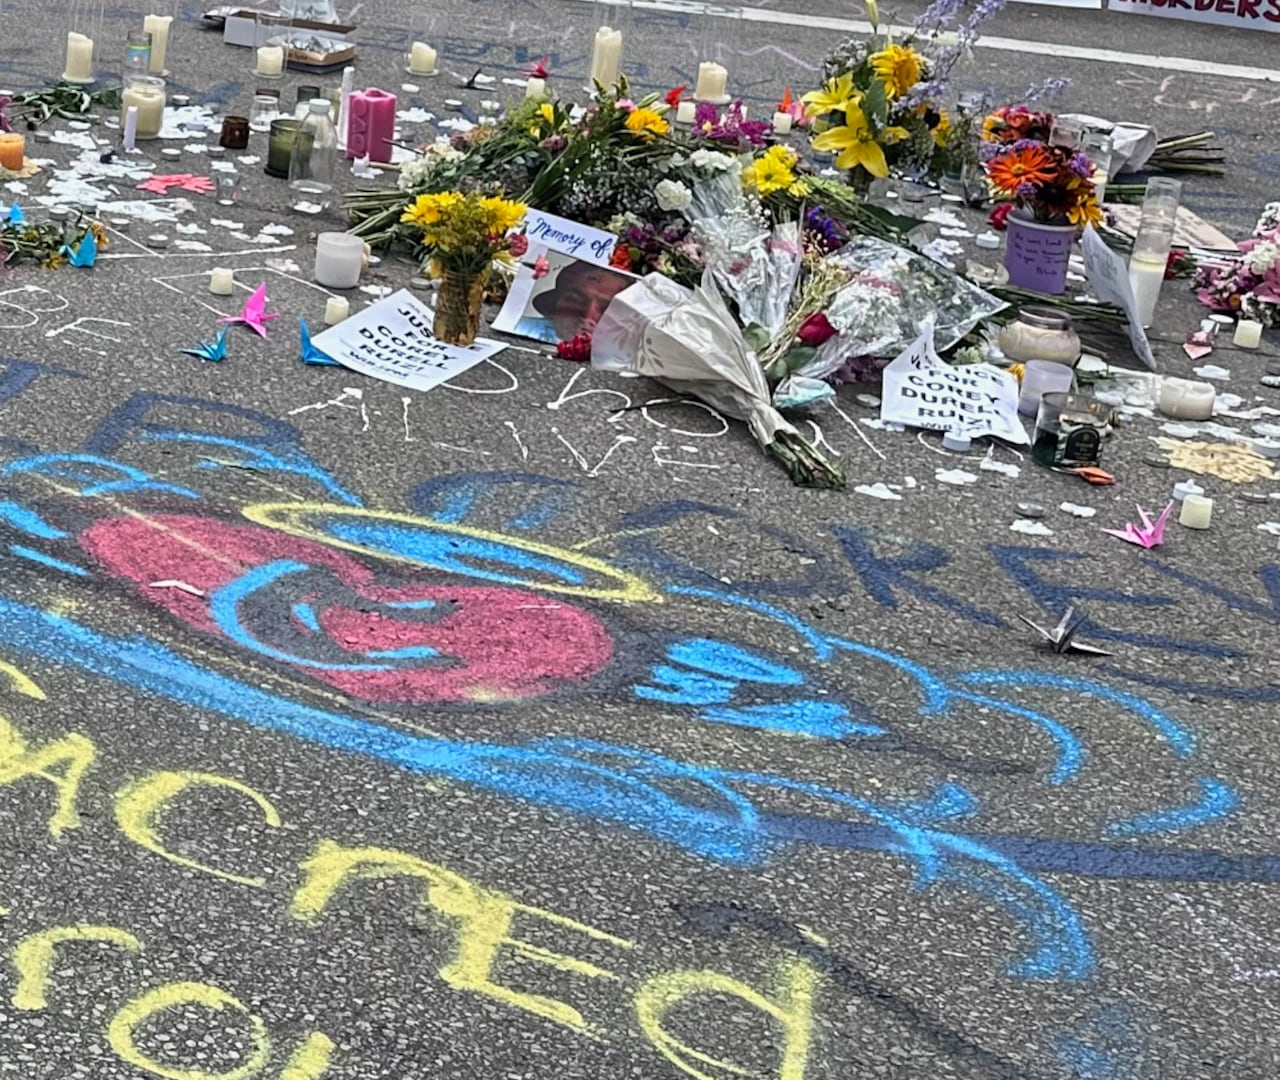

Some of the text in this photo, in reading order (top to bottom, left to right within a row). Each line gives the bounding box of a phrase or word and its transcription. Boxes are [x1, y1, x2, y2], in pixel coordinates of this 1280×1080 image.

[529, 217, 613, 258] Memory of
[358, 328, 449, 370] DURELL
[377, 325, 458, 362] COREY
[405, 331, 448, 352] FOR
[907, 375, 1001, 404] COREY
[928, 370, 978, 387] FOR
